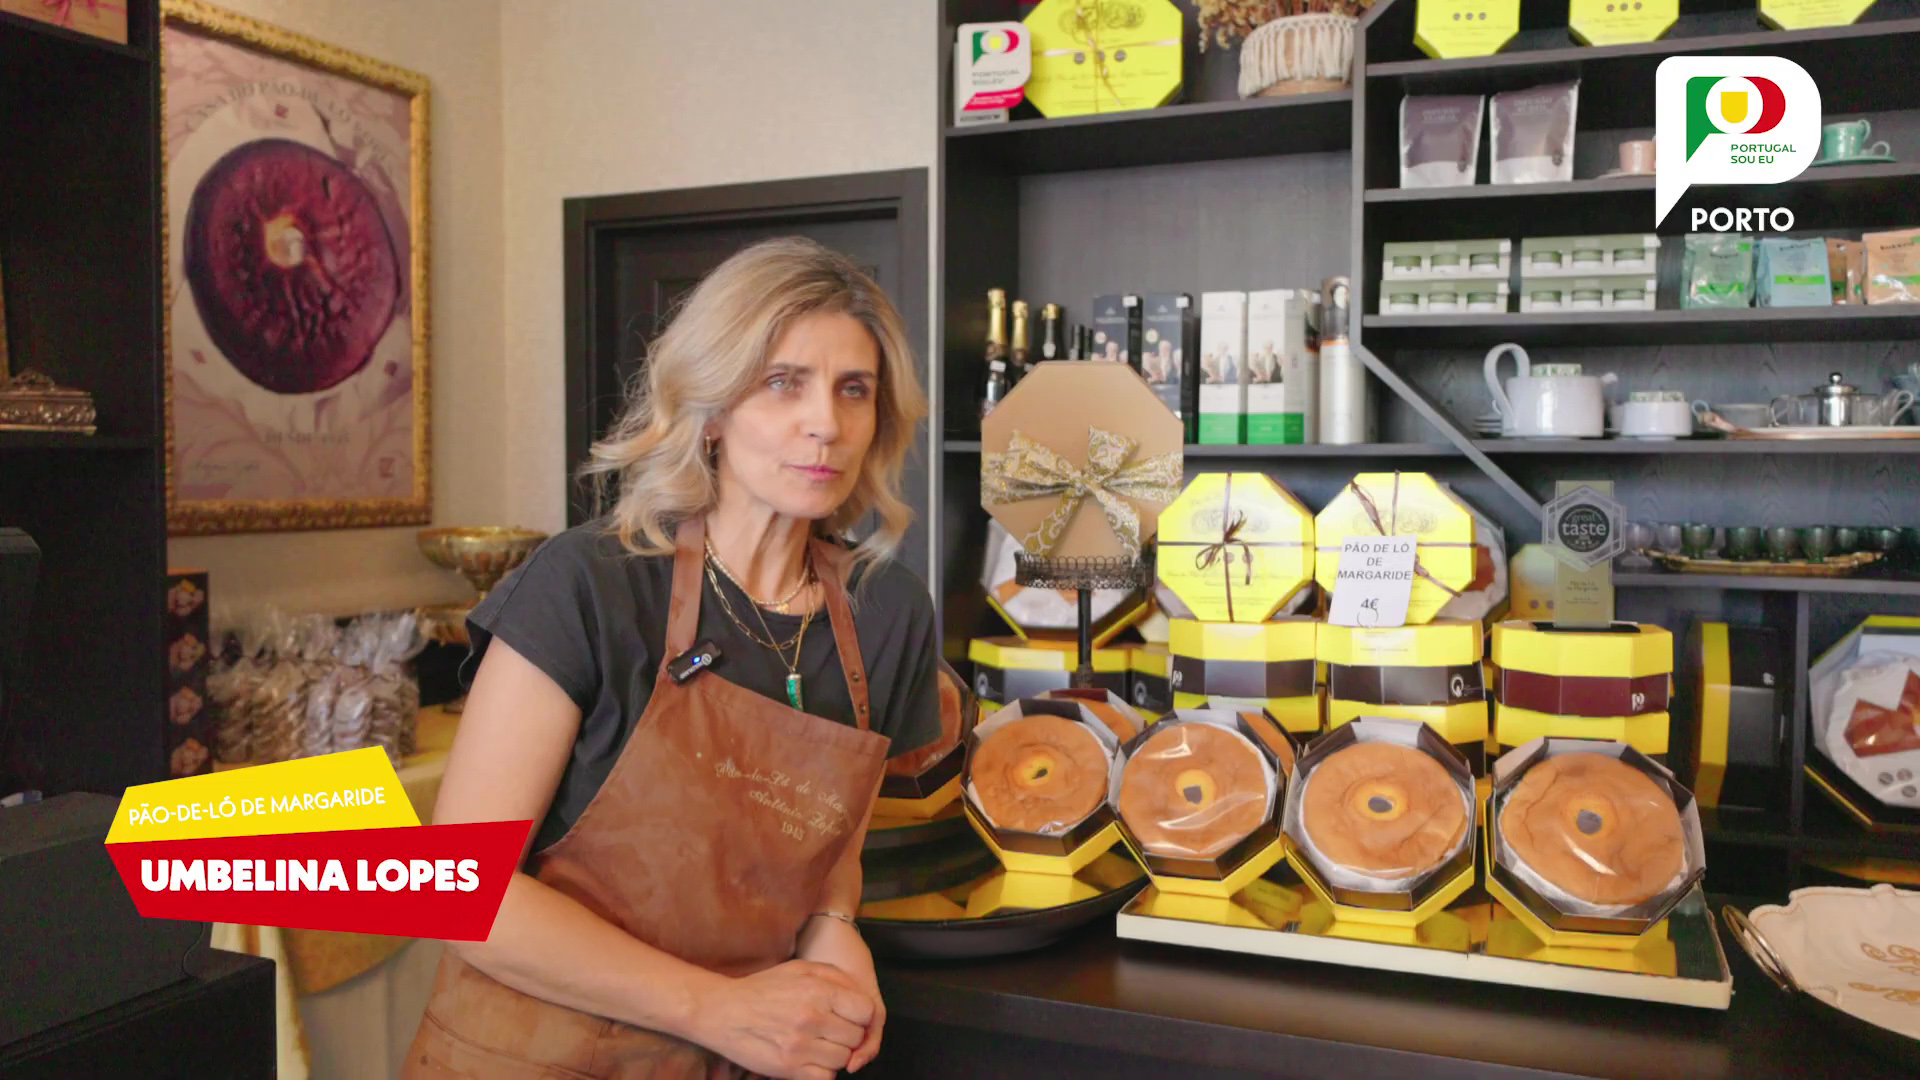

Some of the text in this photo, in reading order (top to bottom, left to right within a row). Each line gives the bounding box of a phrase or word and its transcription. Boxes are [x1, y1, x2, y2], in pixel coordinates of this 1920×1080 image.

[1562, 523, 1607, 536] taste
[1344, 541, 1410, 553] PÃO DE LÓ
[1366, 556, 1383, 567] DE
[1337, 569, 1412, 580] MARGARIDE
[1360, 598, 1380, 610] 4€
